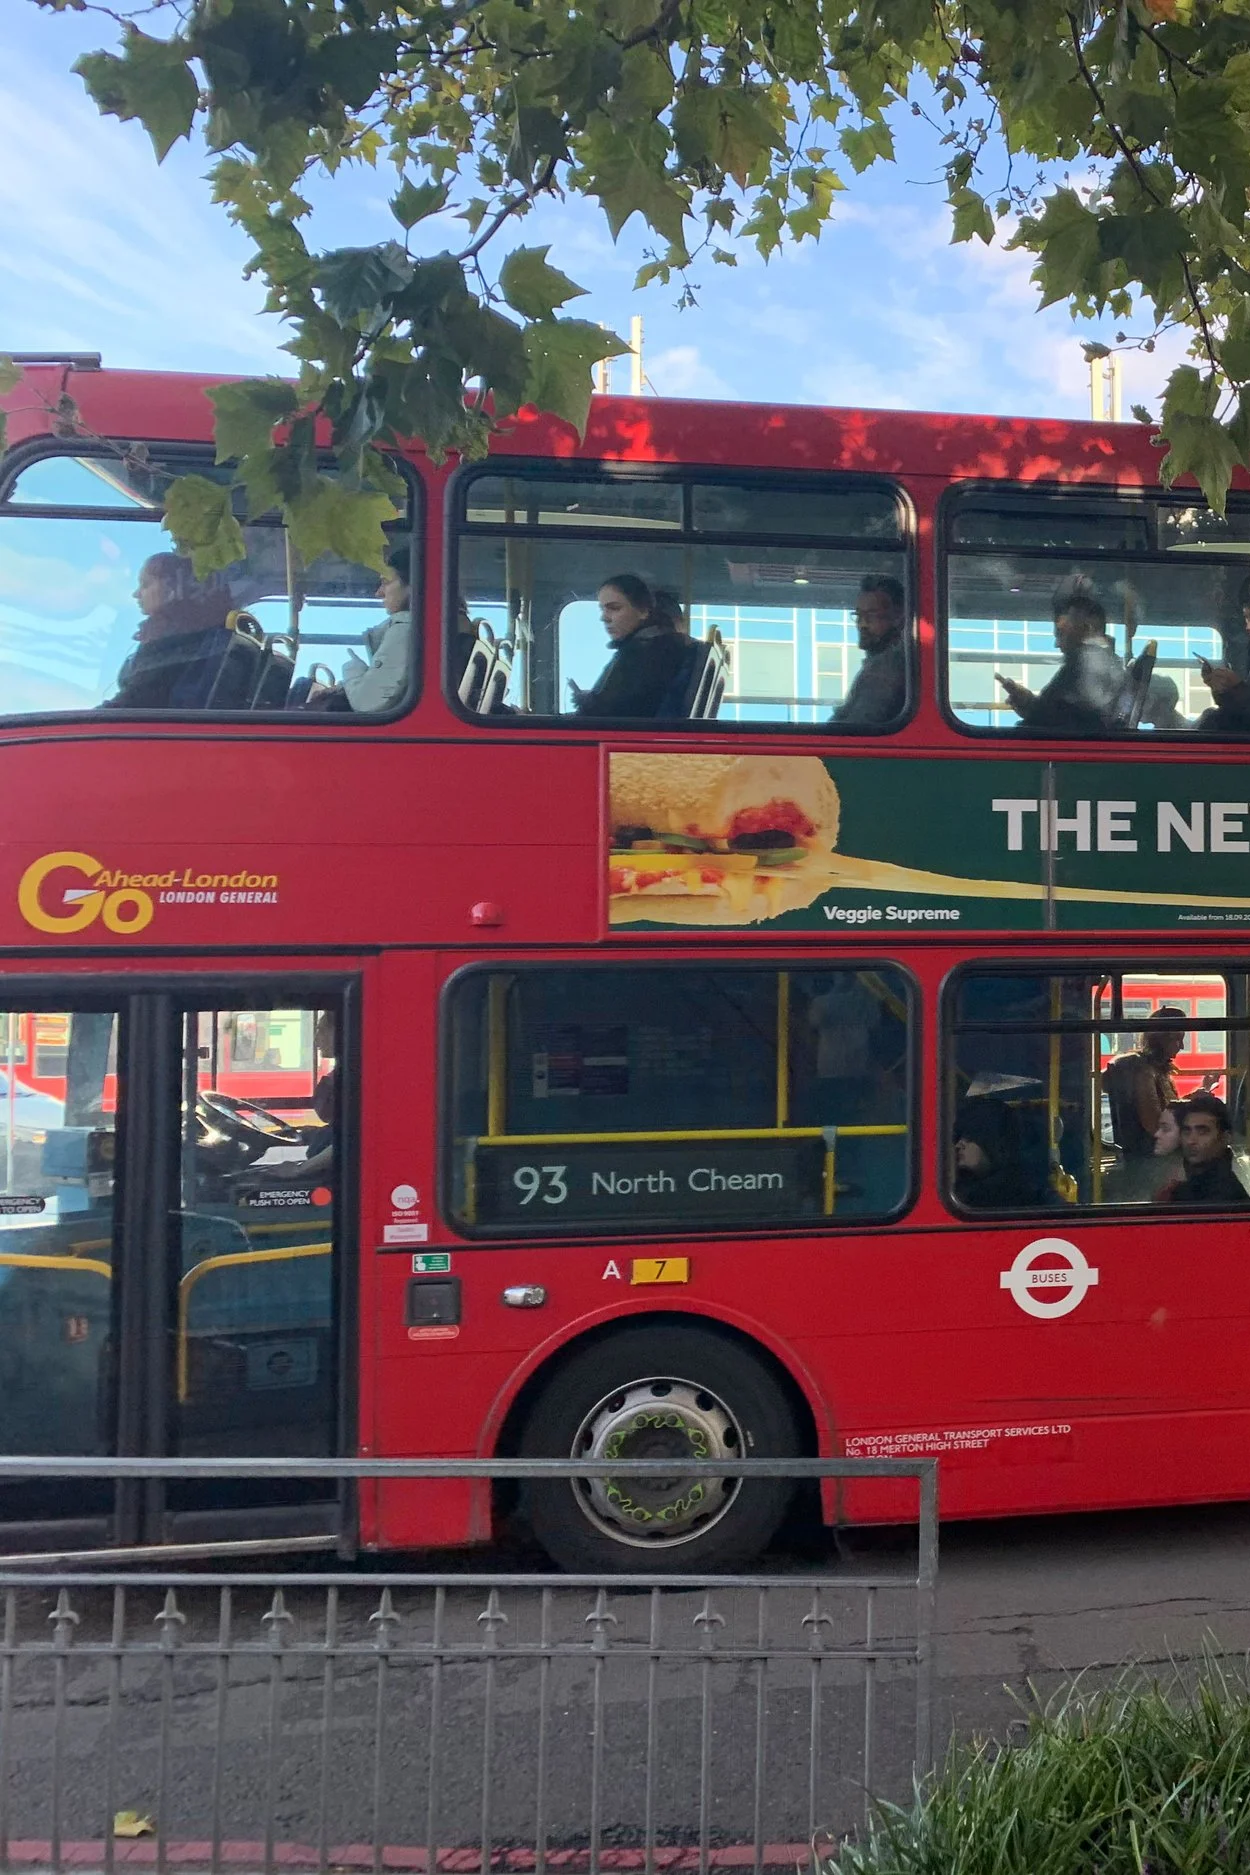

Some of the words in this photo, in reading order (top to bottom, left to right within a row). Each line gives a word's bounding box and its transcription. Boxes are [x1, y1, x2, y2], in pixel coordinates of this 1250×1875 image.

[992, 799, 1137, 851] THE
[18, 851, 154, 934] Go
[94, 869, 278, 887] Ahead-London
[159, 892, 215, 904] LONDON
[219, 892, 277, 904] GENERAL
[823, 906, 882, 924] Veggie
[885, 906, 960, 923] Supreme
[513, 1166, 568, 1205] 93
[591, 1170, 676, 1195] North
[688, 1168, 784, 1192] Cheam
[602, 1260, 621, 1280] A
[655, 1261, 667, 1279] 7
[1032, 1273, 1067, 1283] BUSES
[845, 1436, 893, 1447] LONDON
[894, 1433, 941, 1444] GENERAL
[943, 1429, 1003, 1441] TRANSPORT
[1004, 1426, 1050, 1437] SERVICES
[1051, 1425, 1071, 1434] LTD
[845, 1447, 863, 1456] No.
[867, 1446, 878, 1455] 18
[880, 1443, 924, 1454] MERTON
[925, 1441, 951, 1451] HIGH
[953, 1439, 989, 1450] STREET
